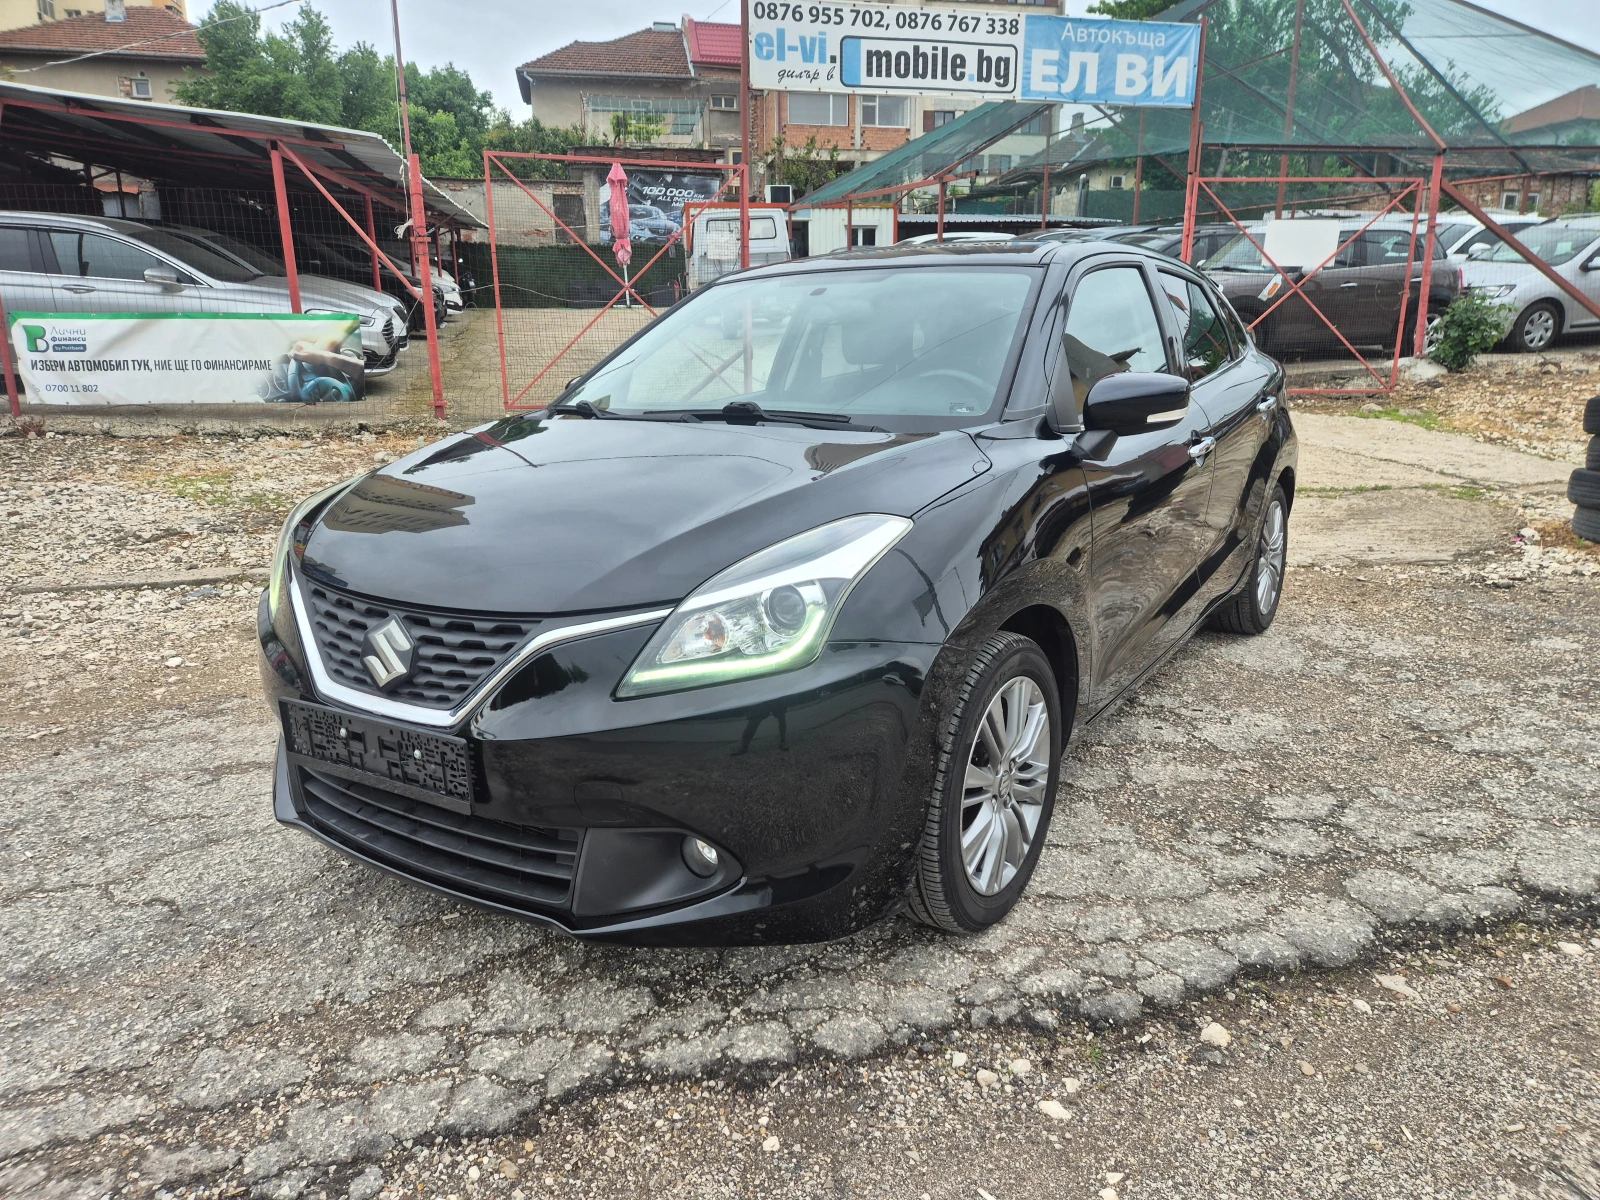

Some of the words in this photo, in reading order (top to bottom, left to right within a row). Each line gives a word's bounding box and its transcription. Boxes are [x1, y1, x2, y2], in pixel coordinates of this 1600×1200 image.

[753, 1, 804, 23] 0876
[808, 5, 844, 25] 955
[849, 8, 890, 31] 702,
[895, 11, 942, 31] 0876
[947, 14, 981, 33] 767
[985, 17, 1019, 36] 338
[1061, 22, 1166, 50] Автокъща
[777, 68, 820, 84] дилър
[826, 66, 836, 81] в
[866, 44, 1011, 88] mobile.bg
[1030, 48, 1100, 95] ЕЛ
[1114, 53, 1189, 98] ВИ
[666, 188, 694, 197] 000
[50, 326, 86, 336] Лични
[30, 359, 66, 372] ИЗБЕРИ
[67, 359, 130, 372] АВТОМОБИЛ
[131, 359, 153, 373] ТУК,
[154, 359, 173, 371] НИЕ
[174, 359, 190, 373] ЩЕ
[191, 359, 201, 371] ГО
[203, 359, 273, 371] ФИНАНСИРАМЕ
[45, 384, 69, 393] 0700
[70, 384, 81, 393] 11
[82, 384, 99, 393] 802
